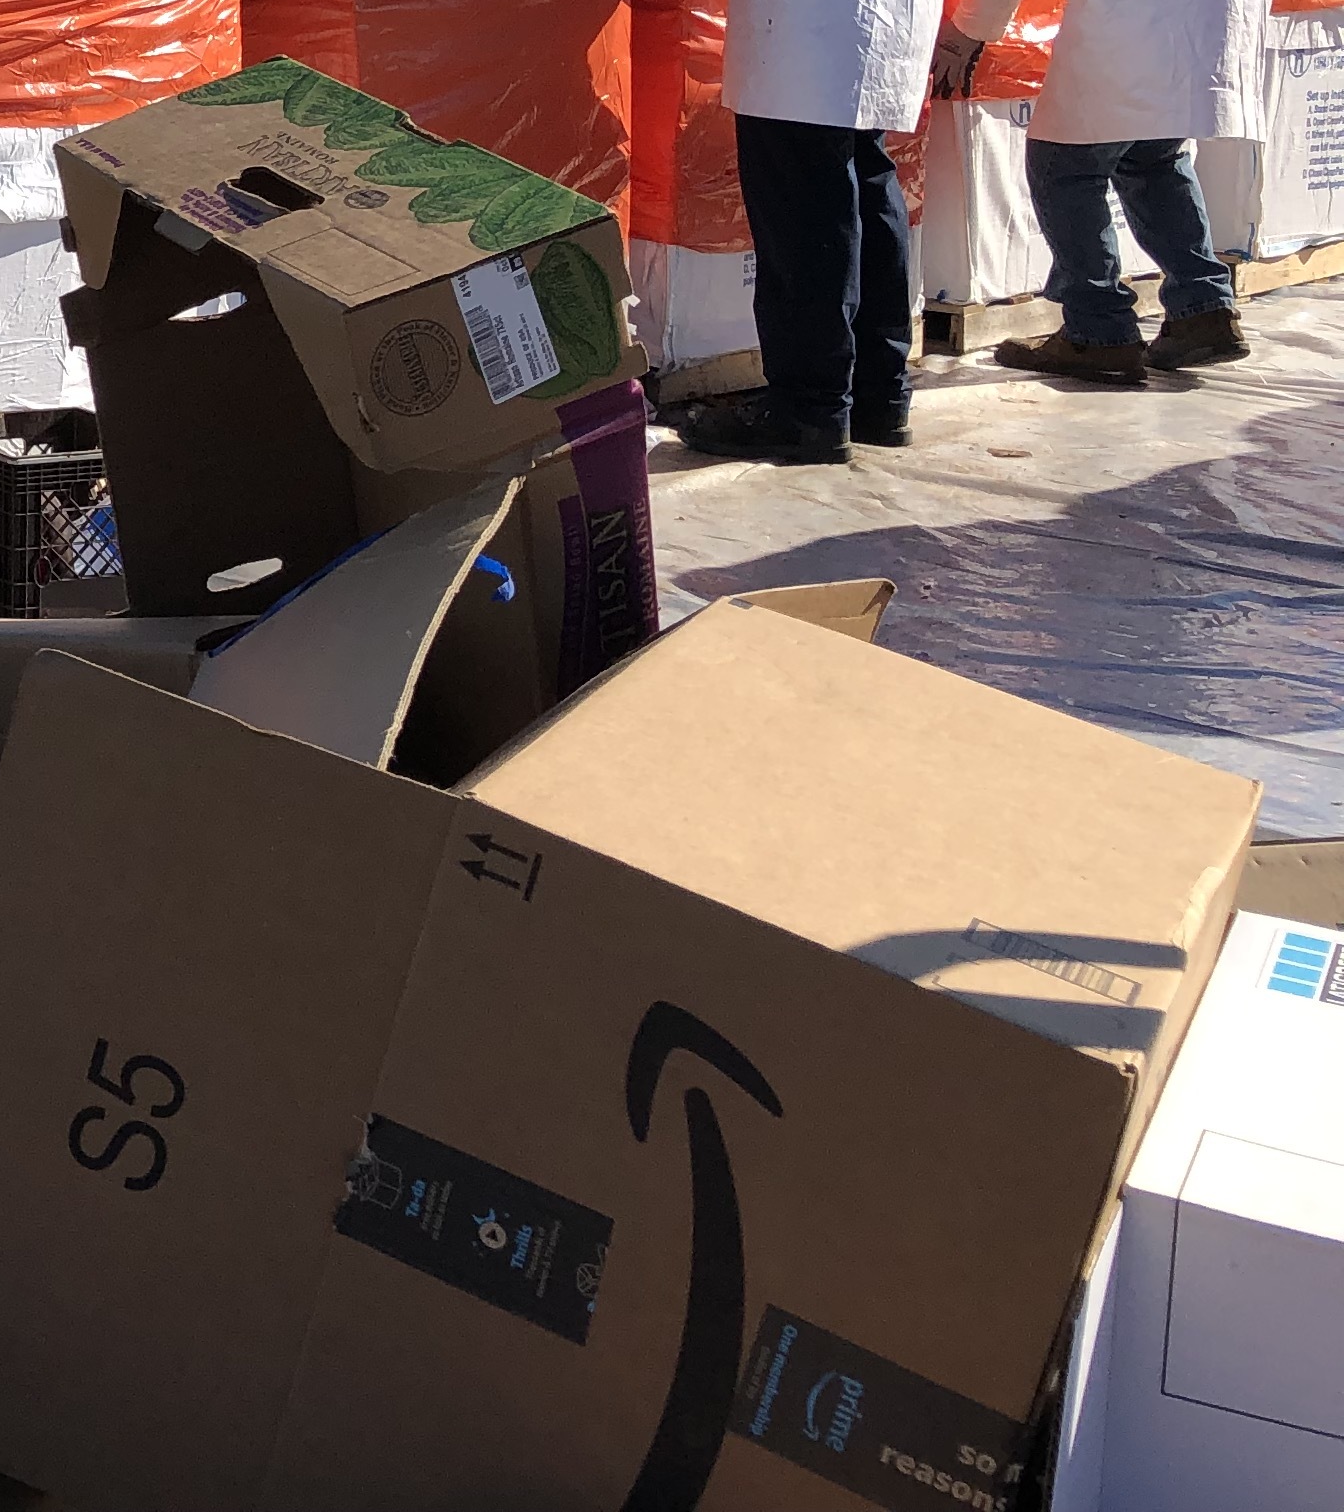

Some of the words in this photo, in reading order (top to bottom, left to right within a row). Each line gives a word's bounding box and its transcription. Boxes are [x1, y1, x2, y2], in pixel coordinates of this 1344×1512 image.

[1331, 89, 1344, 101] Inst
[237, 134, 360, 195] ARTISAN
[276, 131, 339, 165] ROMAINE
[591, 509, 636, 654] TISAN
[633, 496, 655, 621] ROMAINE
[68, 1037, 185, 1191] S5
[404, 1178, 428, 1218] Ta-da
[510, 1224, 534, 1270] Thrills
[775, 1324, 798, 1354] One
[748, 1352, 787, 1437] membership
[825, 1374, 864, 1454] prime
[957, 1444, 997, 1476] so
